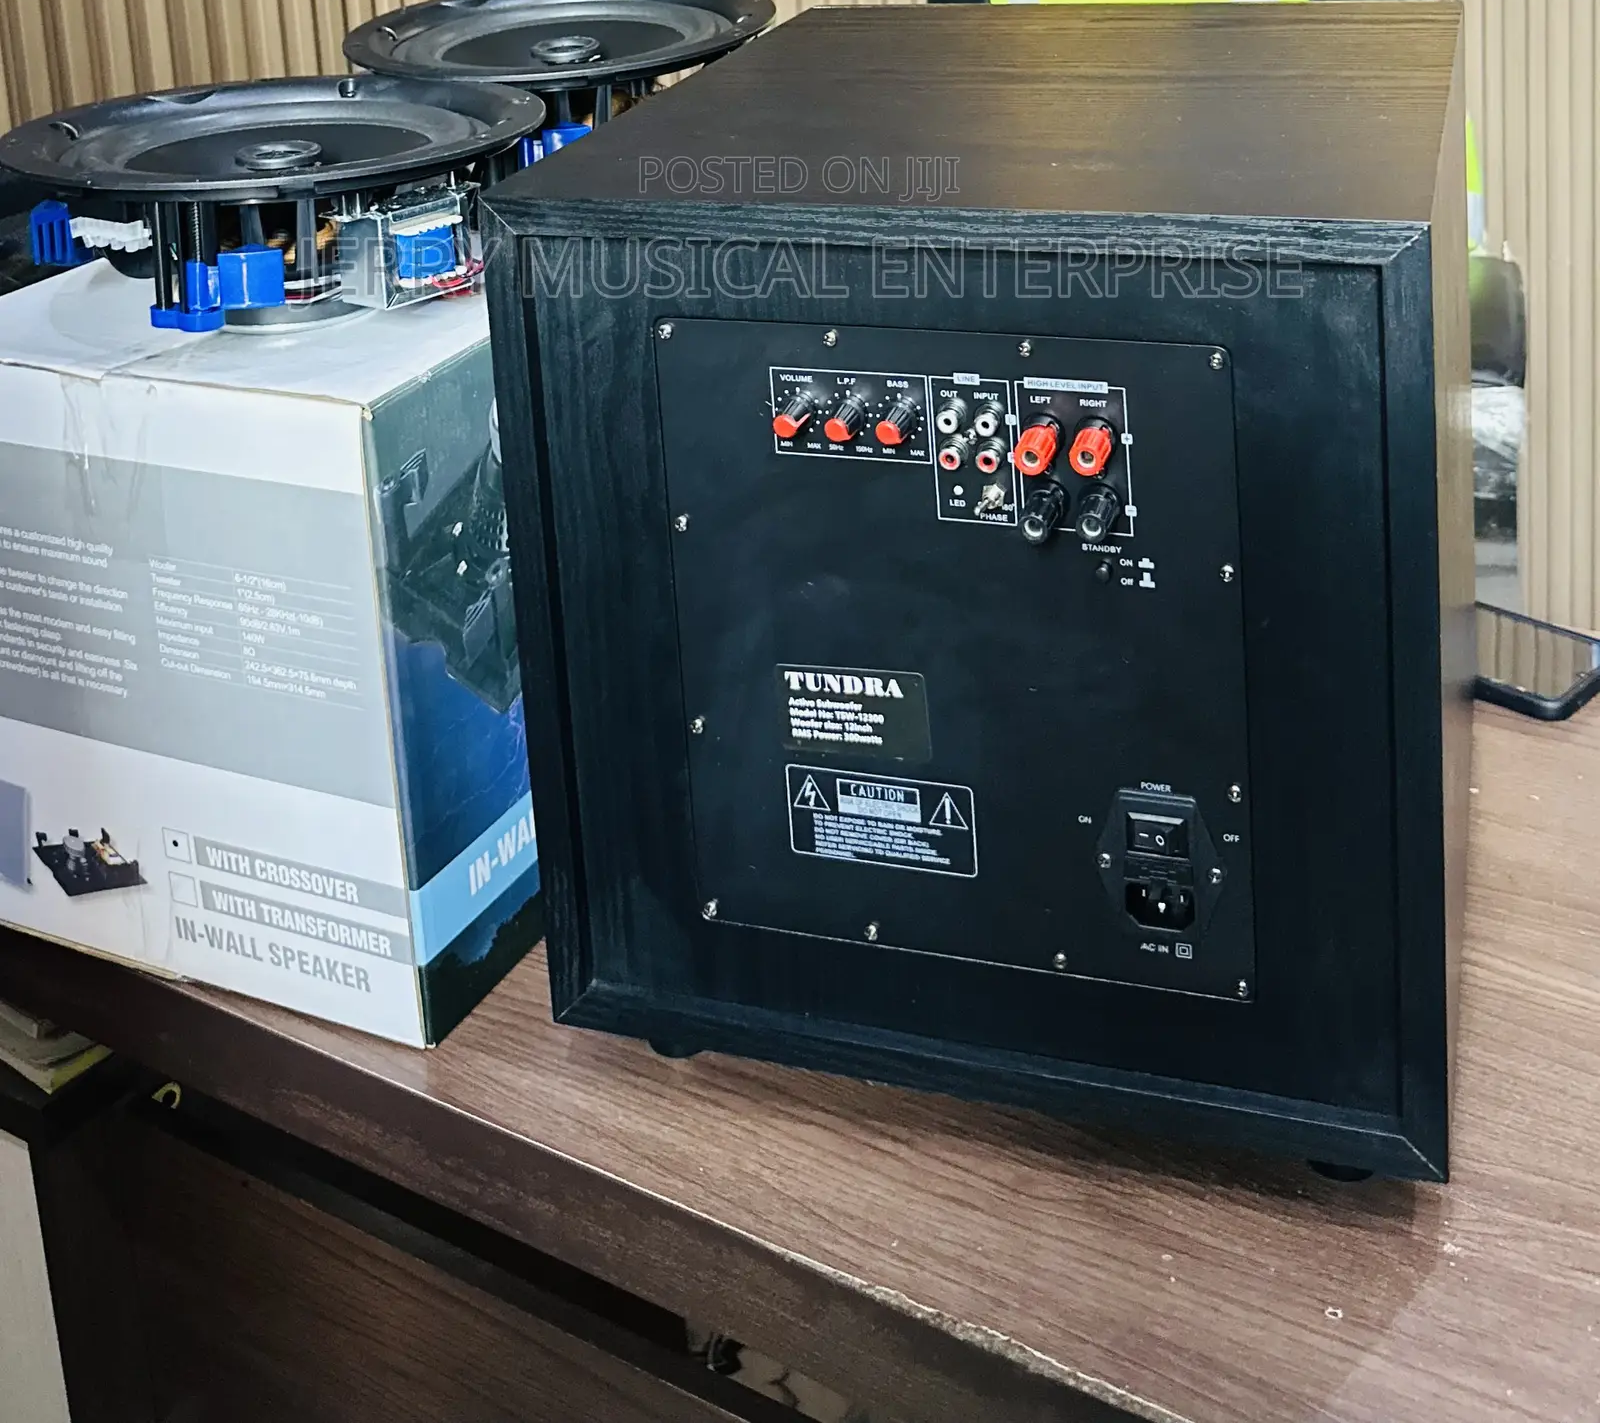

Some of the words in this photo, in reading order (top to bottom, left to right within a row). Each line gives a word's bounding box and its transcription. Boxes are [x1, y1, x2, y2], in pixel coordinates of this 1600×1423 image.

[780, 374, 813, 383] VOLUME
[956, 375, 976, 383] LINE
[886, 380, 909, 388] BASS
[1050, 381, 1075, 389] LEVEL
[1077, 383, 1104, 391] INPUT
[940, 390, 958, 398] OUT
[974, 392, 999, 401] INPUT
[1030, 395, 1052, 404] LEFT
[1080, 399, 1107, 408] RIGHT
[807, 442, 822, 450] MAX
[910, 449, 925, 457] MAX
[949, 499, 966, 507] LED
[980, 513, 1008, 522] PHASE
[1082, 543, 1121, 553] STANDBY
[1120, 558, 1133, 567] ON
[784, 670, 904, 698] TUNDRA
[788, 697, 815, 708] Active
[816, 698, 862, 711] Subwoofer
[790, 707, 816, 718] Model
[790, 718, 823, 729] Woofer
[1140, 781, 1172, 793] POWER
[850, 783, 905, 802] CAUTION
[1078, 815, 1092, 825] ON
[1222, 833, 1240, 843] OFF
[205, 846, 251, 876] WITH
[254, 859, 359, 904] CROSSOVER
[212, 890, 257, 920] WITH
[260, 904, 392, 957] TRANSFORMER
[1140, 942, 1156, 953] AC
[1157, 944, 1169, 954] IN
[175, 915, 264, 962] IN-WALL
[268, 942, 371, 993] SPEAKER
